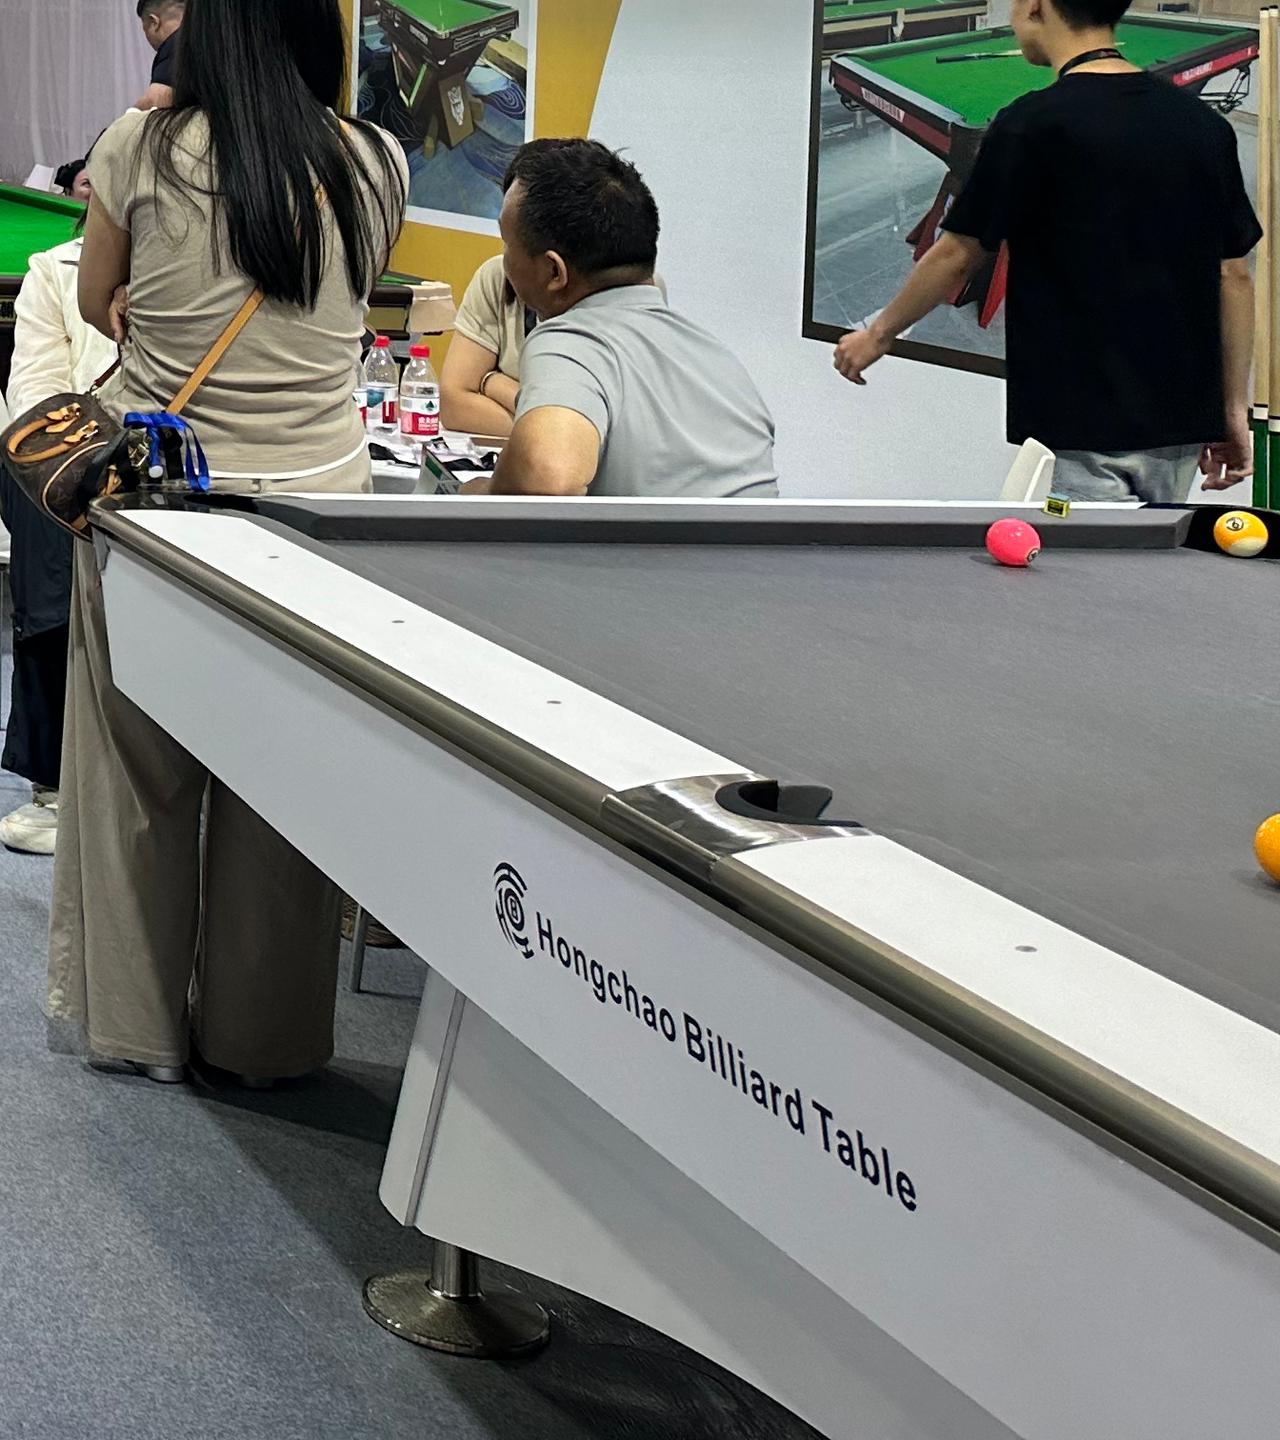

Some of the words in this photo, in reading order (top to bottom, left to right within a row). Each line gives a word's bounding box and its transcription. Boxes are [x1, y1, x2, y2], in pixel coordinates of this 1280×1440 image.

[535, 910, 677, 1043] Hongchao
[682, 1011, 806, 1136] Billiard
[811, 1099, 918, 1213] Table
